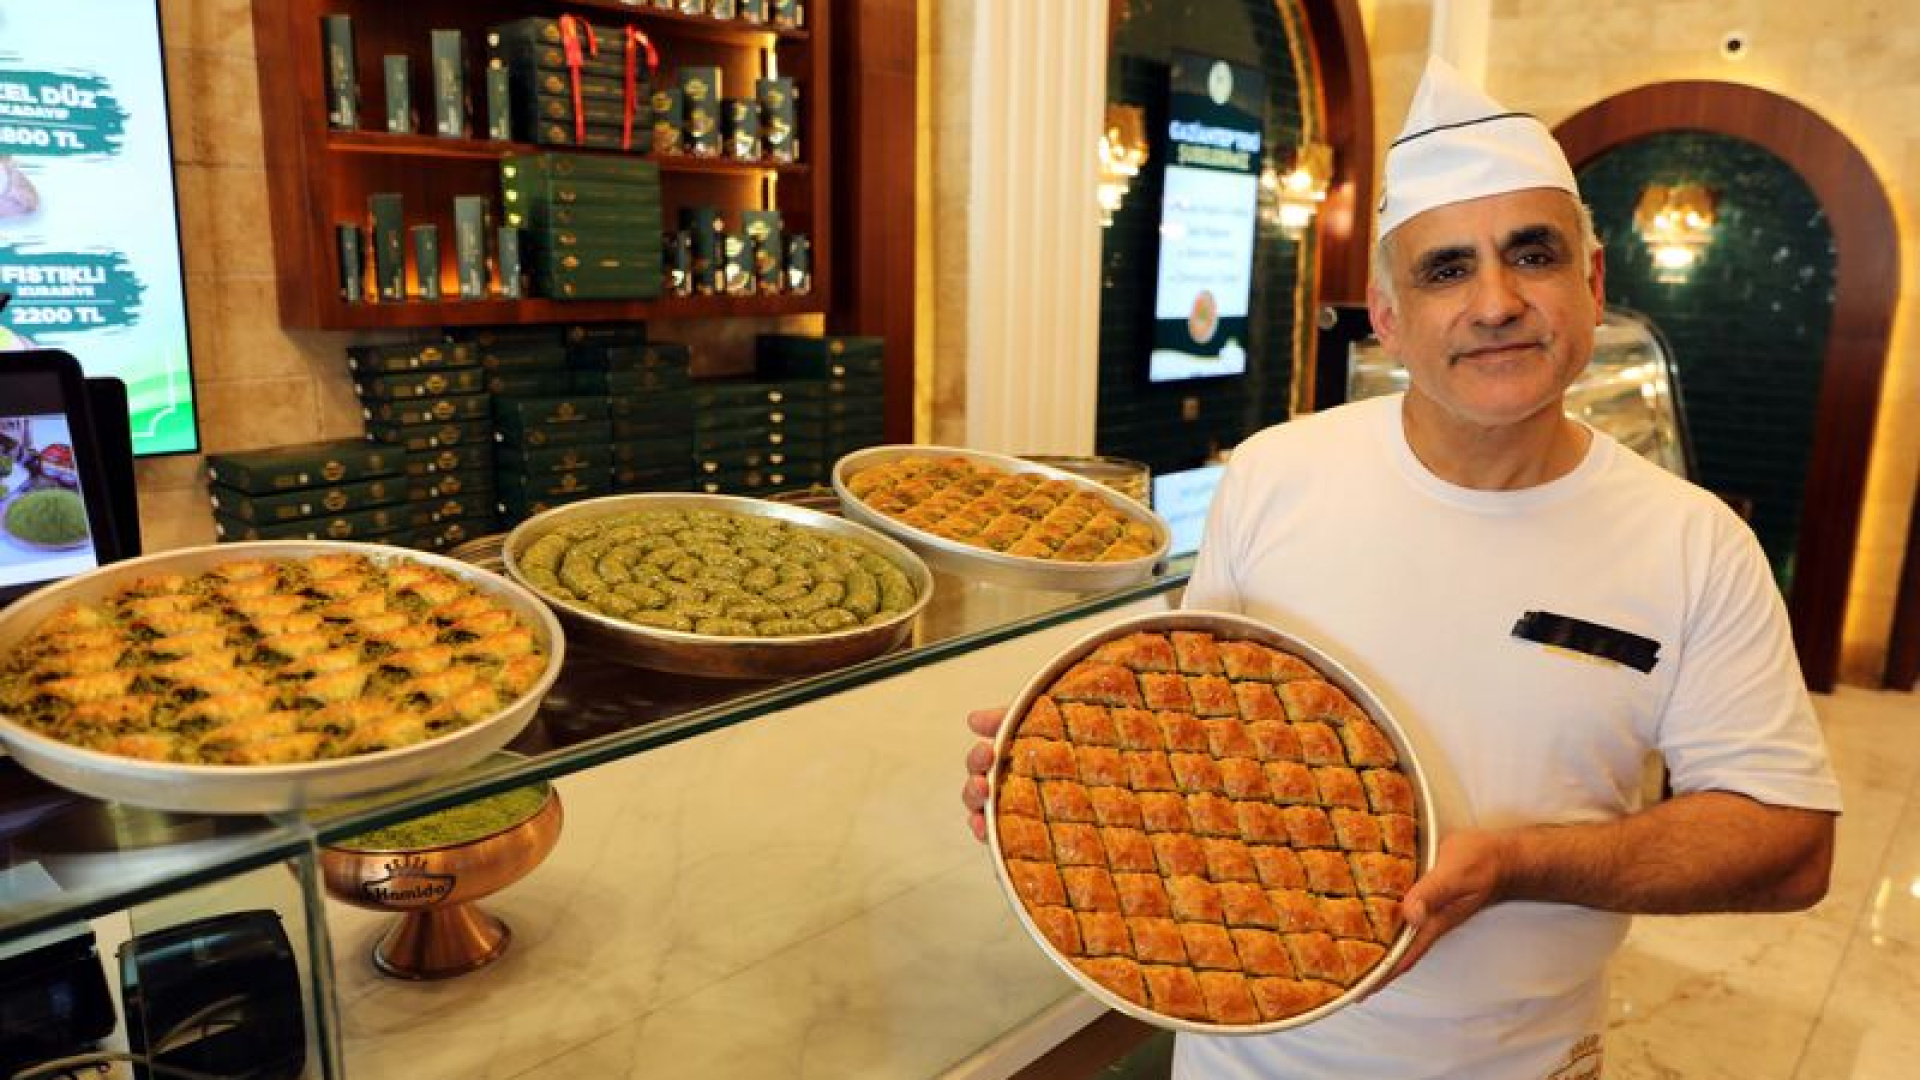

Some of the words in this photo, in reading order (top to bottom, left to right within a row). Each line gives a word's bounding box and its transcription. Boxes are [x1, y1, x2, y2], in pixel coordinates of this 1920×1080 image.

[40, 82, 97, 109] DÜZ
[0, 126, 49, 147] 800
[52, 131, 86, 149] TL
[12, 306, 74, 325] 2200
[75, 306, 107, 324] TL
